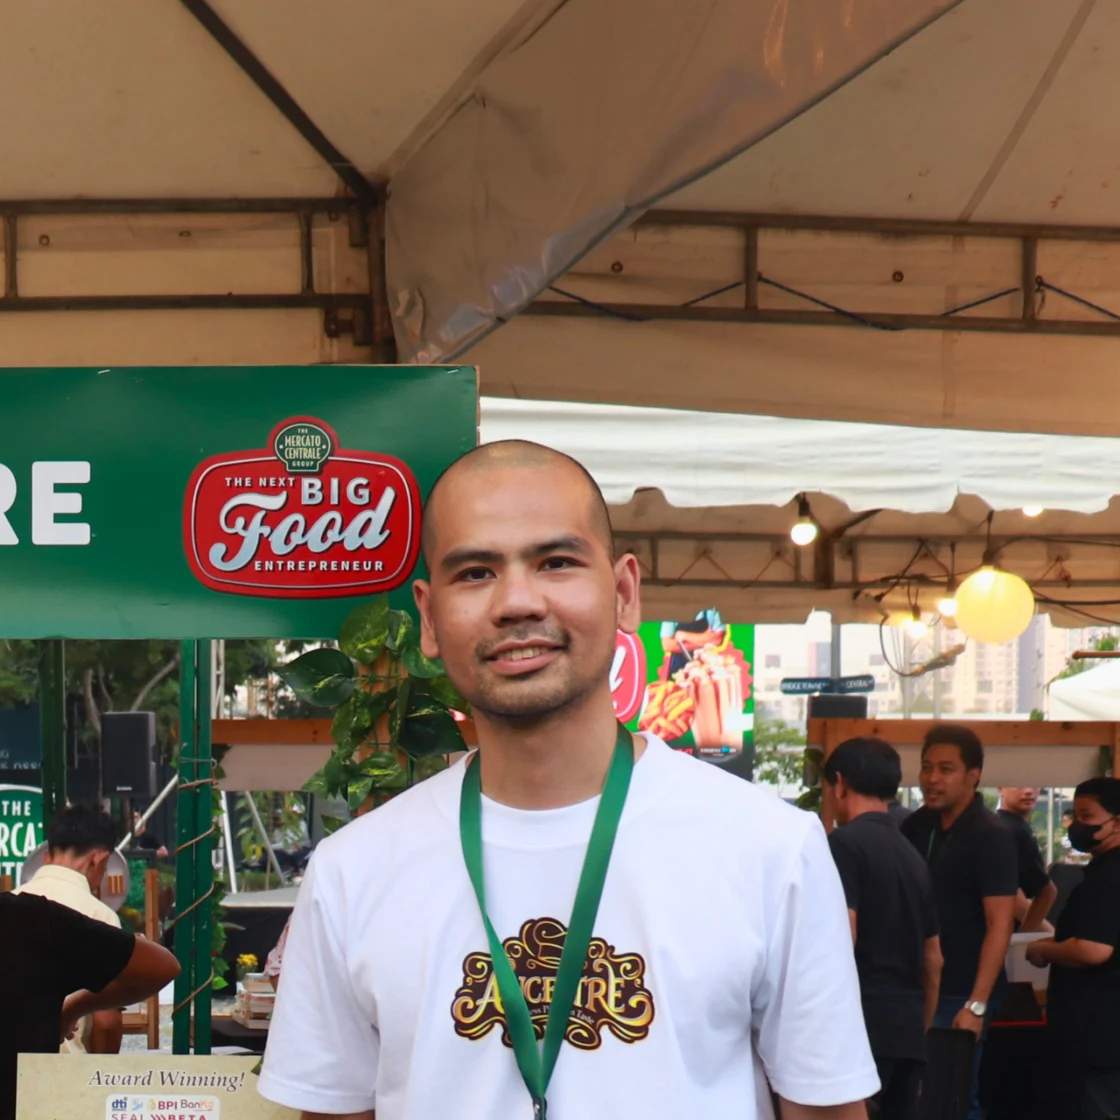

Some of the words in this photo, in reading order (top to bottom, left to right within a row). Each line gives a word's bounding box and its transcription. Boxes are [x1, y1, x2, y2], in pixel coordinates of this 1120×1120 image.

[284, 435, 321, 447] MERCATO
[284, 447, 321, 459] CENTRALE
[225, 477, 252, 487] THE
[259, 477, 295, 487] NEXT
[301, 476, 371, 506] BIG
[209, 486, 396, 572] Food
[254, 560, 384, 572] ENTREPRENEUR
[1, 800, 31, 816] THE
[88, 1069, 153, 1087] Award
[159, 1071, 246, 1093] Winning!
[158, 1101, 178, 1110] BPI
